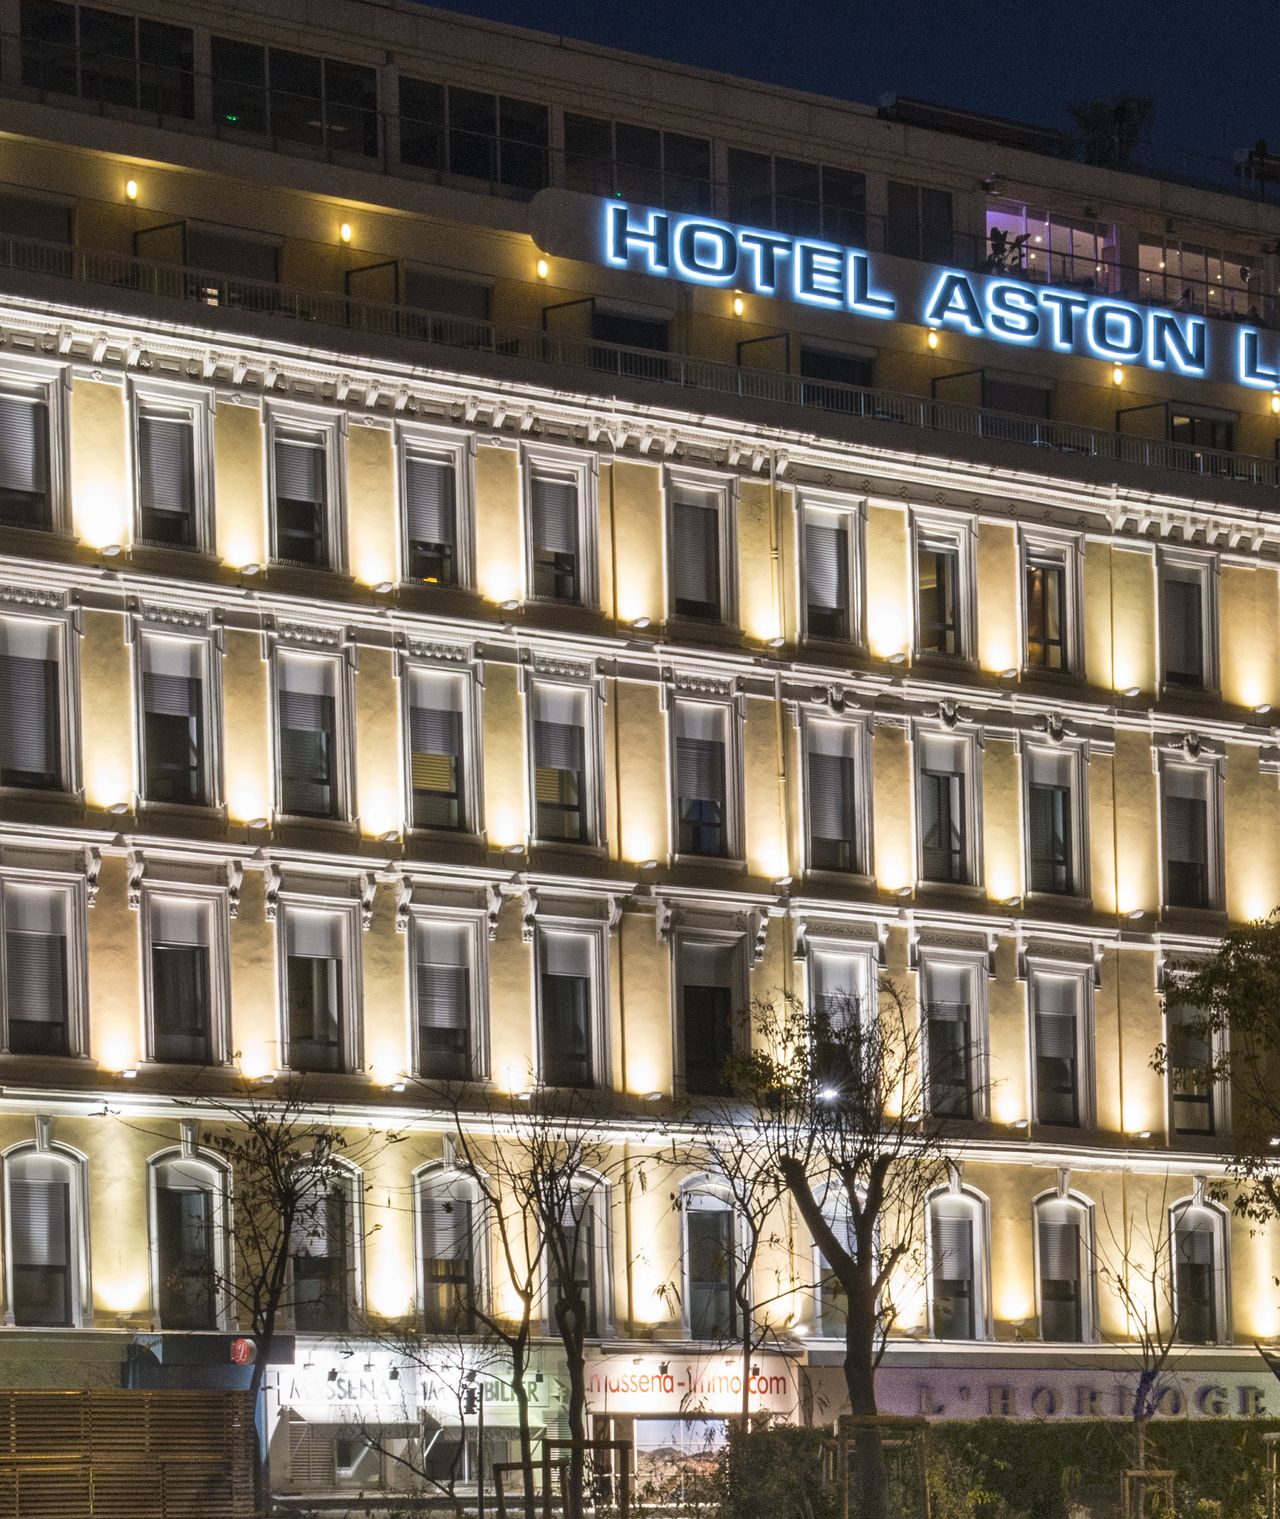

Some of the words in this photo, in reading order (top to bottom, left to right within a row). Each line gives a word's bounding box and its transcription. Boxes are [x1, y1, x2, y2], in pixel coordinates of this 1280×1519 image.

[606, 200, 896, 318] HOTEL
[924, 269, 1210, 378] ASTON
[587, 1366, 787, 1396] massena-immocom
